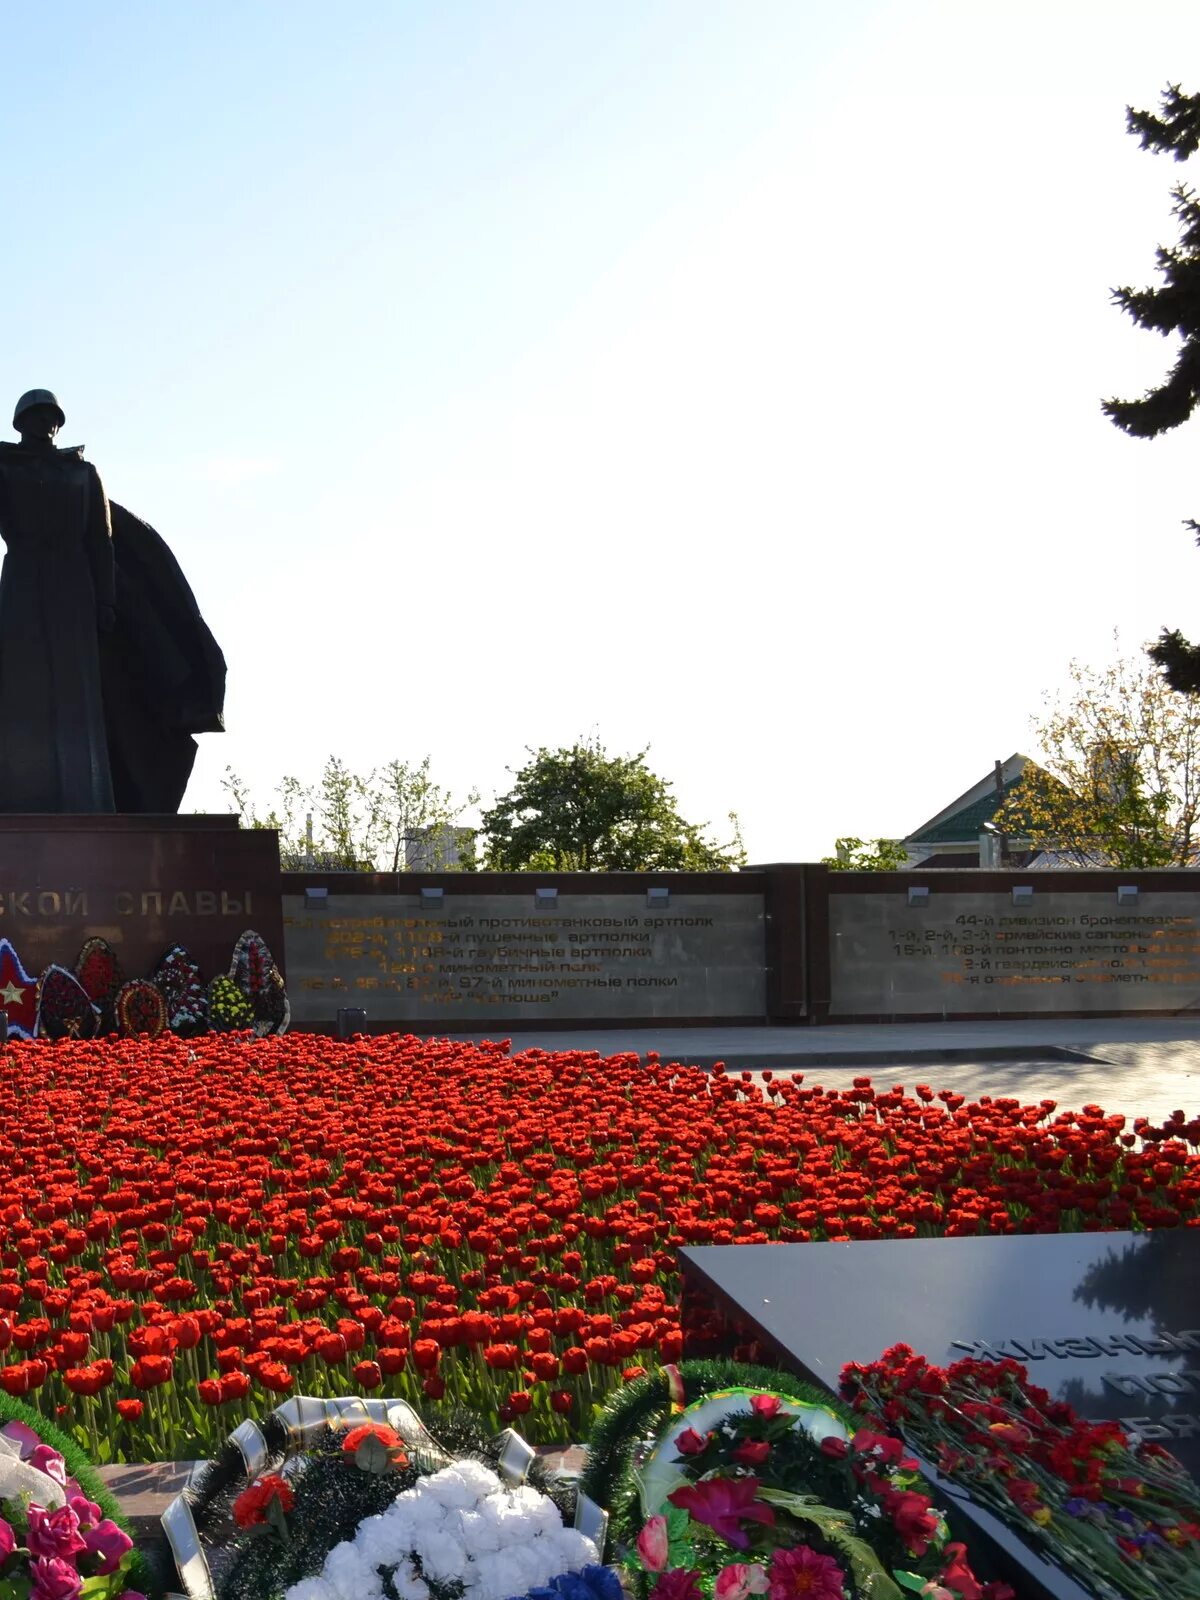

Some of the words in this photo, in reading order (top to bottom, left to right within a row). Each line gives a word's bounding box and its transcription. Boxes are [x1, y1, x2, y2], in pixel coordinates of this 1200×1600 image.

[114, 890, 253, 917] СЛАВЫ
[478, 915, 638, 930] противотанковый
[643, 917, 714, 929] артполк
[956, 914, 994, 926] 44-й
[568, 932, 650, 945] артполки
[570, 948, 653, 960] артполки
[627, 977, 679, 987] полки
